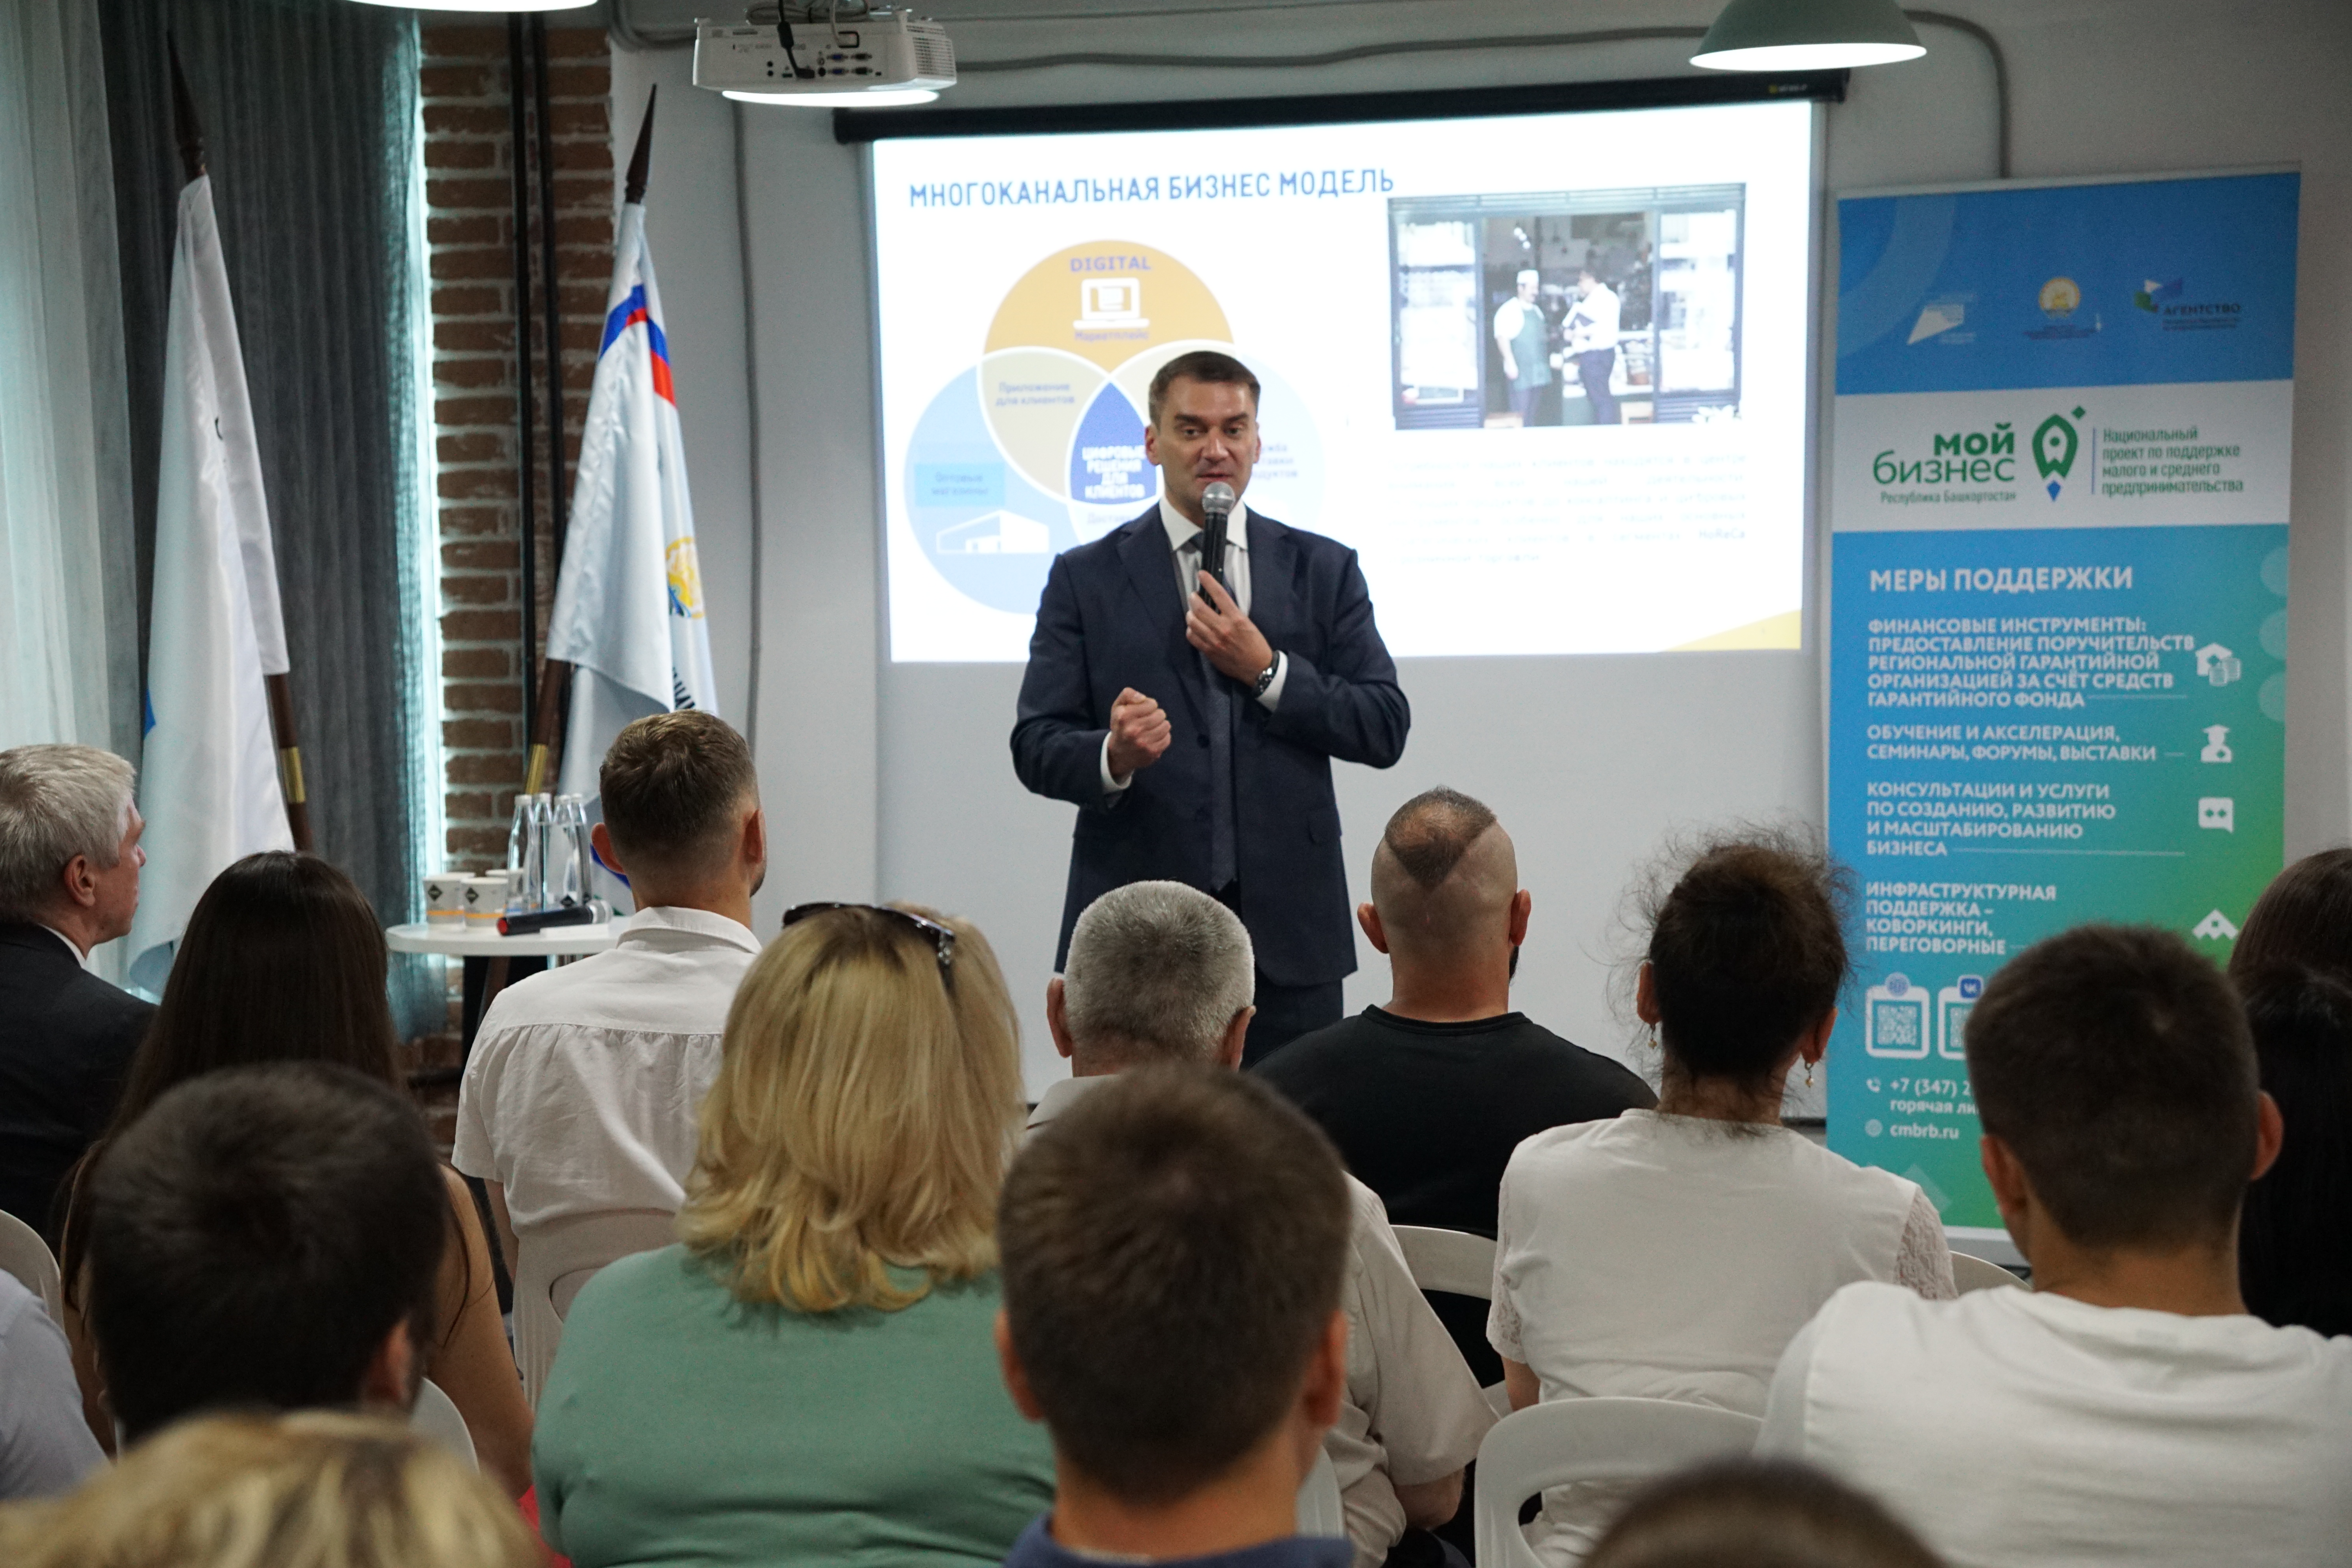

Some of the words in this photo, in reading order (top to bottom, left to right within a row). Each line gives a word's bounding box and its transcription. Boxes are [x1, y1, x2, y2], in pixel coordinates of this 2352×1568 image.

[910, 176, 1159, 207] МНОГОКАНАЛЬНАЯ
[1169, 173, 1270, 200] БИЗНЕС
[1279, 169, 1394, 198] МОДЕЛЬ
[1070, 256, 1151, 272] DIGITAL
[1934, 423, 2014, 456] мой
[2103, 426, 2198, 443] Национальный
[2103, 446, 2143, 463] проект
[2148, 446, 2163, 457] по
[2167, 444, 2240, 459] поддержке
[1873, 450, 2014, 484] бизнес
[2103, 464, 2145, 477] малого
[2150, 464, 2157, 475] и
[2161, 462, 2220, 478] среднего
[1881, 490, 1940, 505] Республика
[1944, 489, 2016, 503] Башкортостан
[2102, 479, 2243, 497] предпринимательства
[1871, 570, 1946, 592] МЕРЫ
[1955, 567, 2133, 593] ПОДДЕРЖКИ
[1868, 617, 1996, 634] ФИНАНСОВЫЕ
[2001, 616, 2146, 633] ИНСТРУМЕНТЫ:
[1868, 637, 2033, 654] ПРЕДОСТАВЛЕНИЕ
[2038, 635, 2195, 651] ПОРУЧИТЕЛЬСТВ
[1868, 651, 2016, 671] РЕГИОНАЛЬНОЙ
[2020, 651, 2159, 670] ГАРАНТИЙНОЙ
[1868, 670, 2013, 690] ОРГАНИЗАЦИЕЙ
[2017, 673, 2040, 688] ЗА
[2043, 671, 2089, 689] СЧЁТ
[2093, 673, 2173, 690] СРЕДСТВ
[1867, 688, 2009, 708] ГАРАНТИЙНОГО
[2014, 691, 2085, 709] ФОНДА
[1867, 726, 1961, 742] ОБУЧЕНИЕ
[1965, 726, 1979, 740] И
[1982, 726, 2120, 743] АКСЕЛЕРАЦИЯ,
[1867, 744, 1969, 761] СЕМИНАРЫ,
[1972, 745, 2056, 762] ФОРУМЫ,
[2060, 746, 2156, 761] ВЫСТАВКИ
[1867, 783, 2014, 800] КОНСУЛЬТАЦИИ
[2020, 784, 2033, 798] И
[2038, 784, 2109, 799] УСЛУГИ
[1867, 802, 1894, 817] ПО
[1897, 802, 2008, 820] СОЗДАНИЮ,
[2013, 803, 2116, 819] РАЗВИТИЮ
[1867, 822, 1880, 835] И
[1884, 822, 2082, 838] МАСШТАБИРОВАНИЮ
[1867, 841, 1947, 856] БИЗНЕСА
[1866, 882, 2057, 901] ИНФРАСТРУКТУРНАЯ
[1866, 900, 1980, 918] ПОДДЕРЖКА
[1866, 919, 1993, 937] КОВОРКИНГИ,
[1866, 937, 2006, 955] ПЕРЕГОВОРНЫЕ
[1891, 1077, 1909, 1092] +7
[1915, 1078, 1957, 1098] (347)
[1962, 1080, 1971, 1096] 2
[1890, 1100, 1953, 1115] горячая
[1956, 1103, 1979, 1114] ли
[1890, 1123, 1959, 1139] cmbrb.ru
